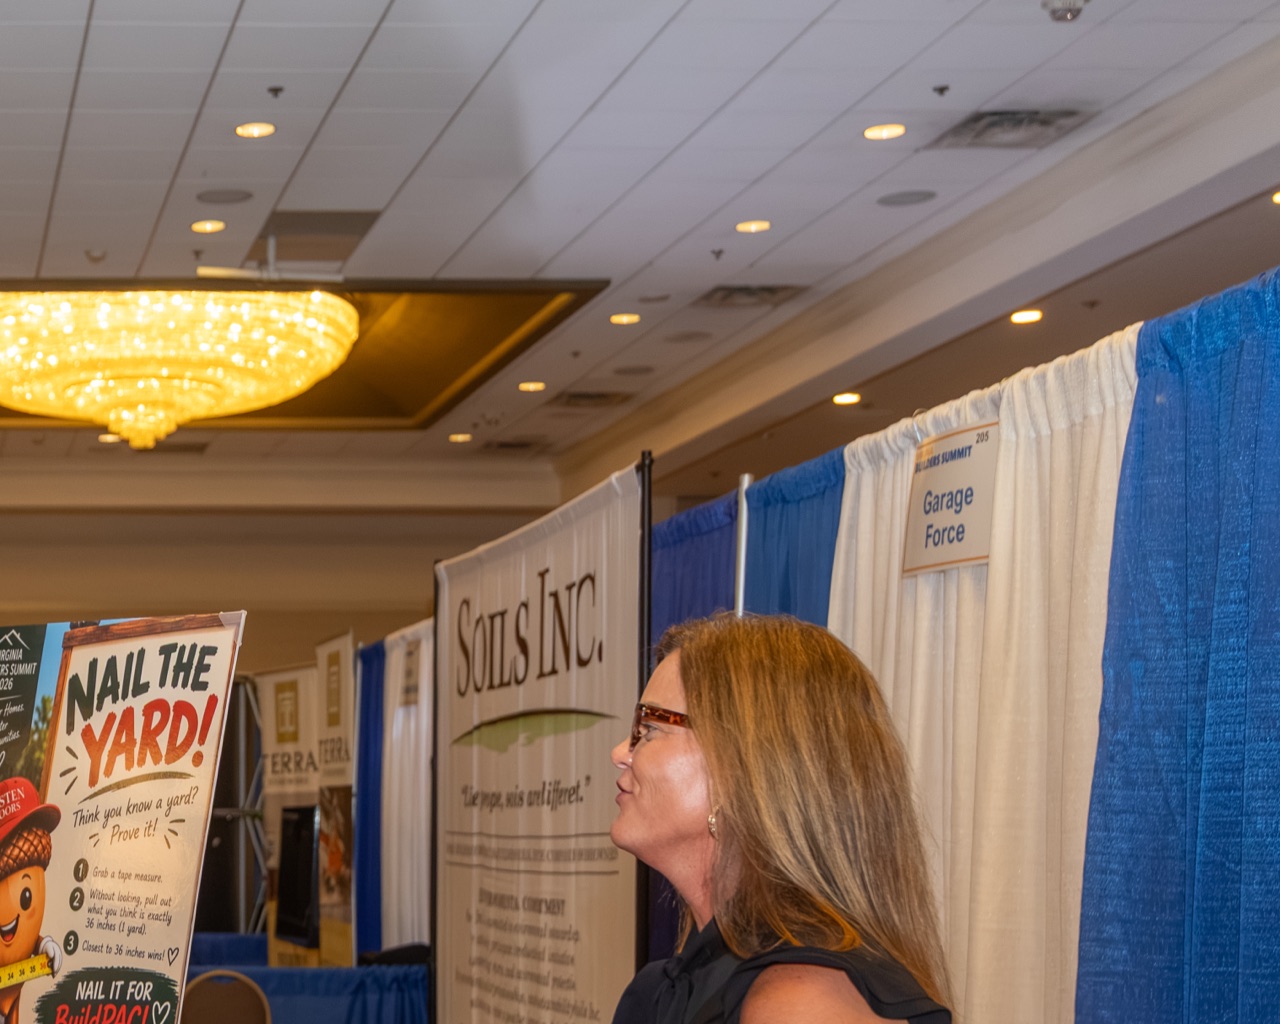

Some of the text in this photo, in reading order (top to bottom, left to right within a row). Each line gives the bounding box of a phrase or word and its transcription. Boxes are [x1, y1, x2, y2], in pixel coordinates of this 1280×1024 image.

[976, 431, 990, 444] 205
[942, 444, 973, 464] SUMMIT
[923, 486, 974, 516] Garage
[924, 522, 966, 550] Force
[10, 662, 38, 676] SUMMIT
[66, 642, 218, 736] NAIL THE
[80, 693, 219, 789] YARD!
[72, 785, 199, 830] Think you know a yard?
[110, 817, 158, 846] Prove it!
[78, 862, 163, 884] 1 Grab a tape measure.
[72, 888, 172, 908] 2 Without looking, pull out
[88, 902, 172, 926] what you think is exactly
[85, 918, 147, 937] 36 inches (1 yard).
[67, 935, 165, 961] 3 Closest to 36 inches wins!
[76, 980, 154, 1001] NAIL IT FOR
